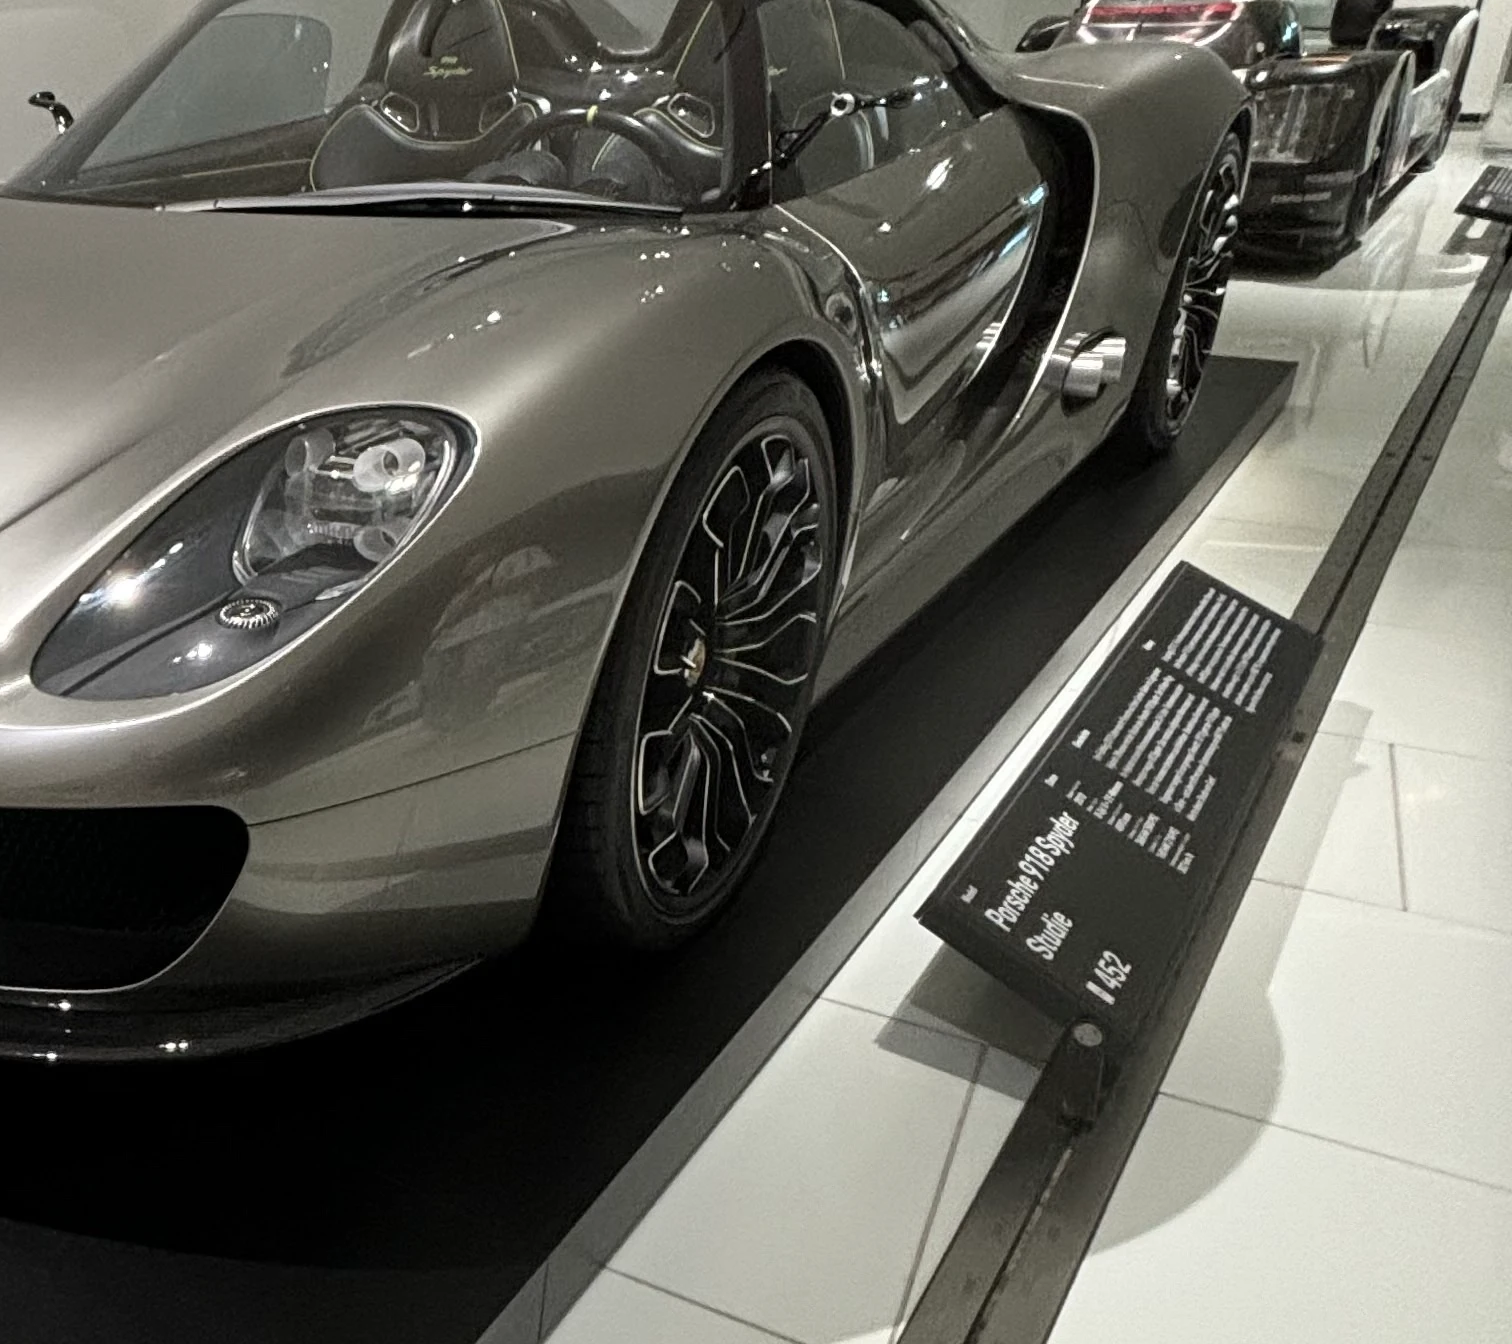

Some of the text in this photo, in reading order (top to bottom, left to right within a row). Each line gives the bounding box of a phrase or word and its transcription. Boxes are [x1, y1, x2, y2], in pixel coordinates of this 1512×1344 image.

[984, 810, 1080, 932] Porsche 918 Spyder
[1025, 911, 1073, 961] Studie
[1093, 950, 1133, 990] 452
